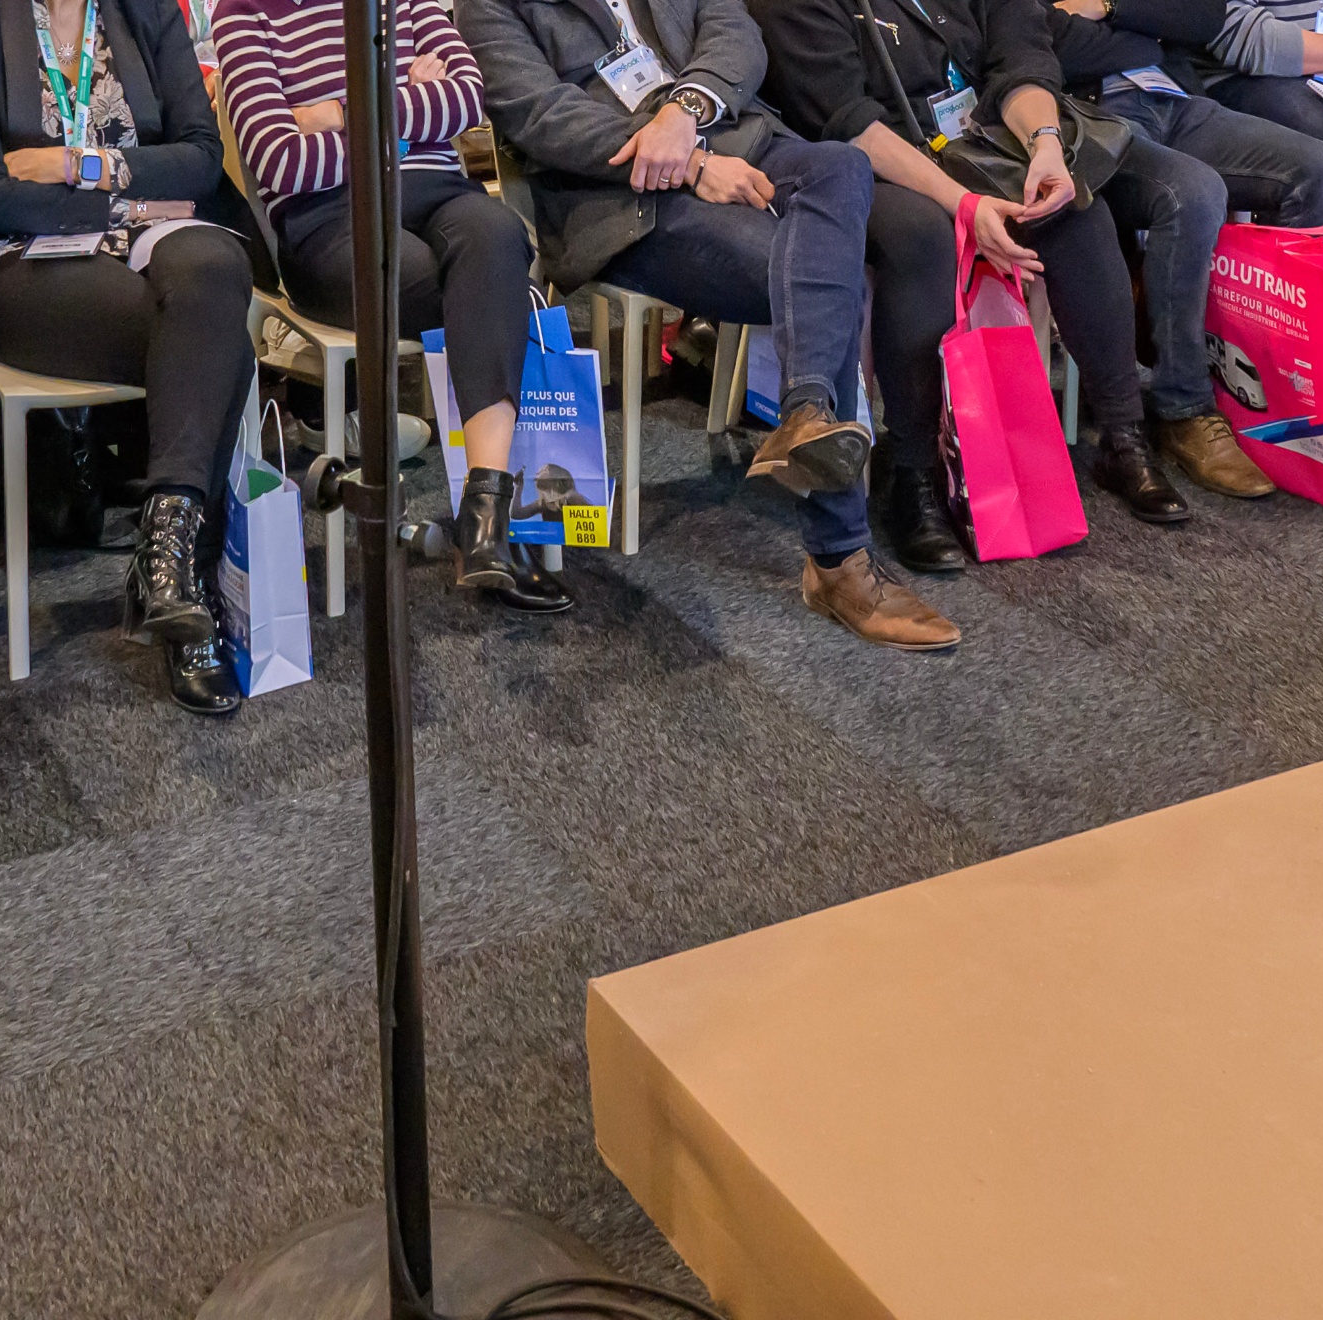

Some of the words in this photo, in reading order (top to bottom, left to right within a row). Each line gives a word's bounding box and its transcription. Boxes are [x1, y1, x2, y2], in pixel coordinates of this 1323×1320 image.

[1210, 252, 1307, 309] SOLUTRANS
[1210, 283, 1263, 313] ARREFOUR
[1265, 304, 1308, 333] MONDIAL
[527, 391, 552, 401] PLUS
[554, 391, 575, 402] QUE
[559, 406, 577, 416] DES
[569, 509, 592, 519] HALL
[593, 509, 599, 519] 6
[575, 521, 595, 531] A90
[577, 533, 596, 544] B89
